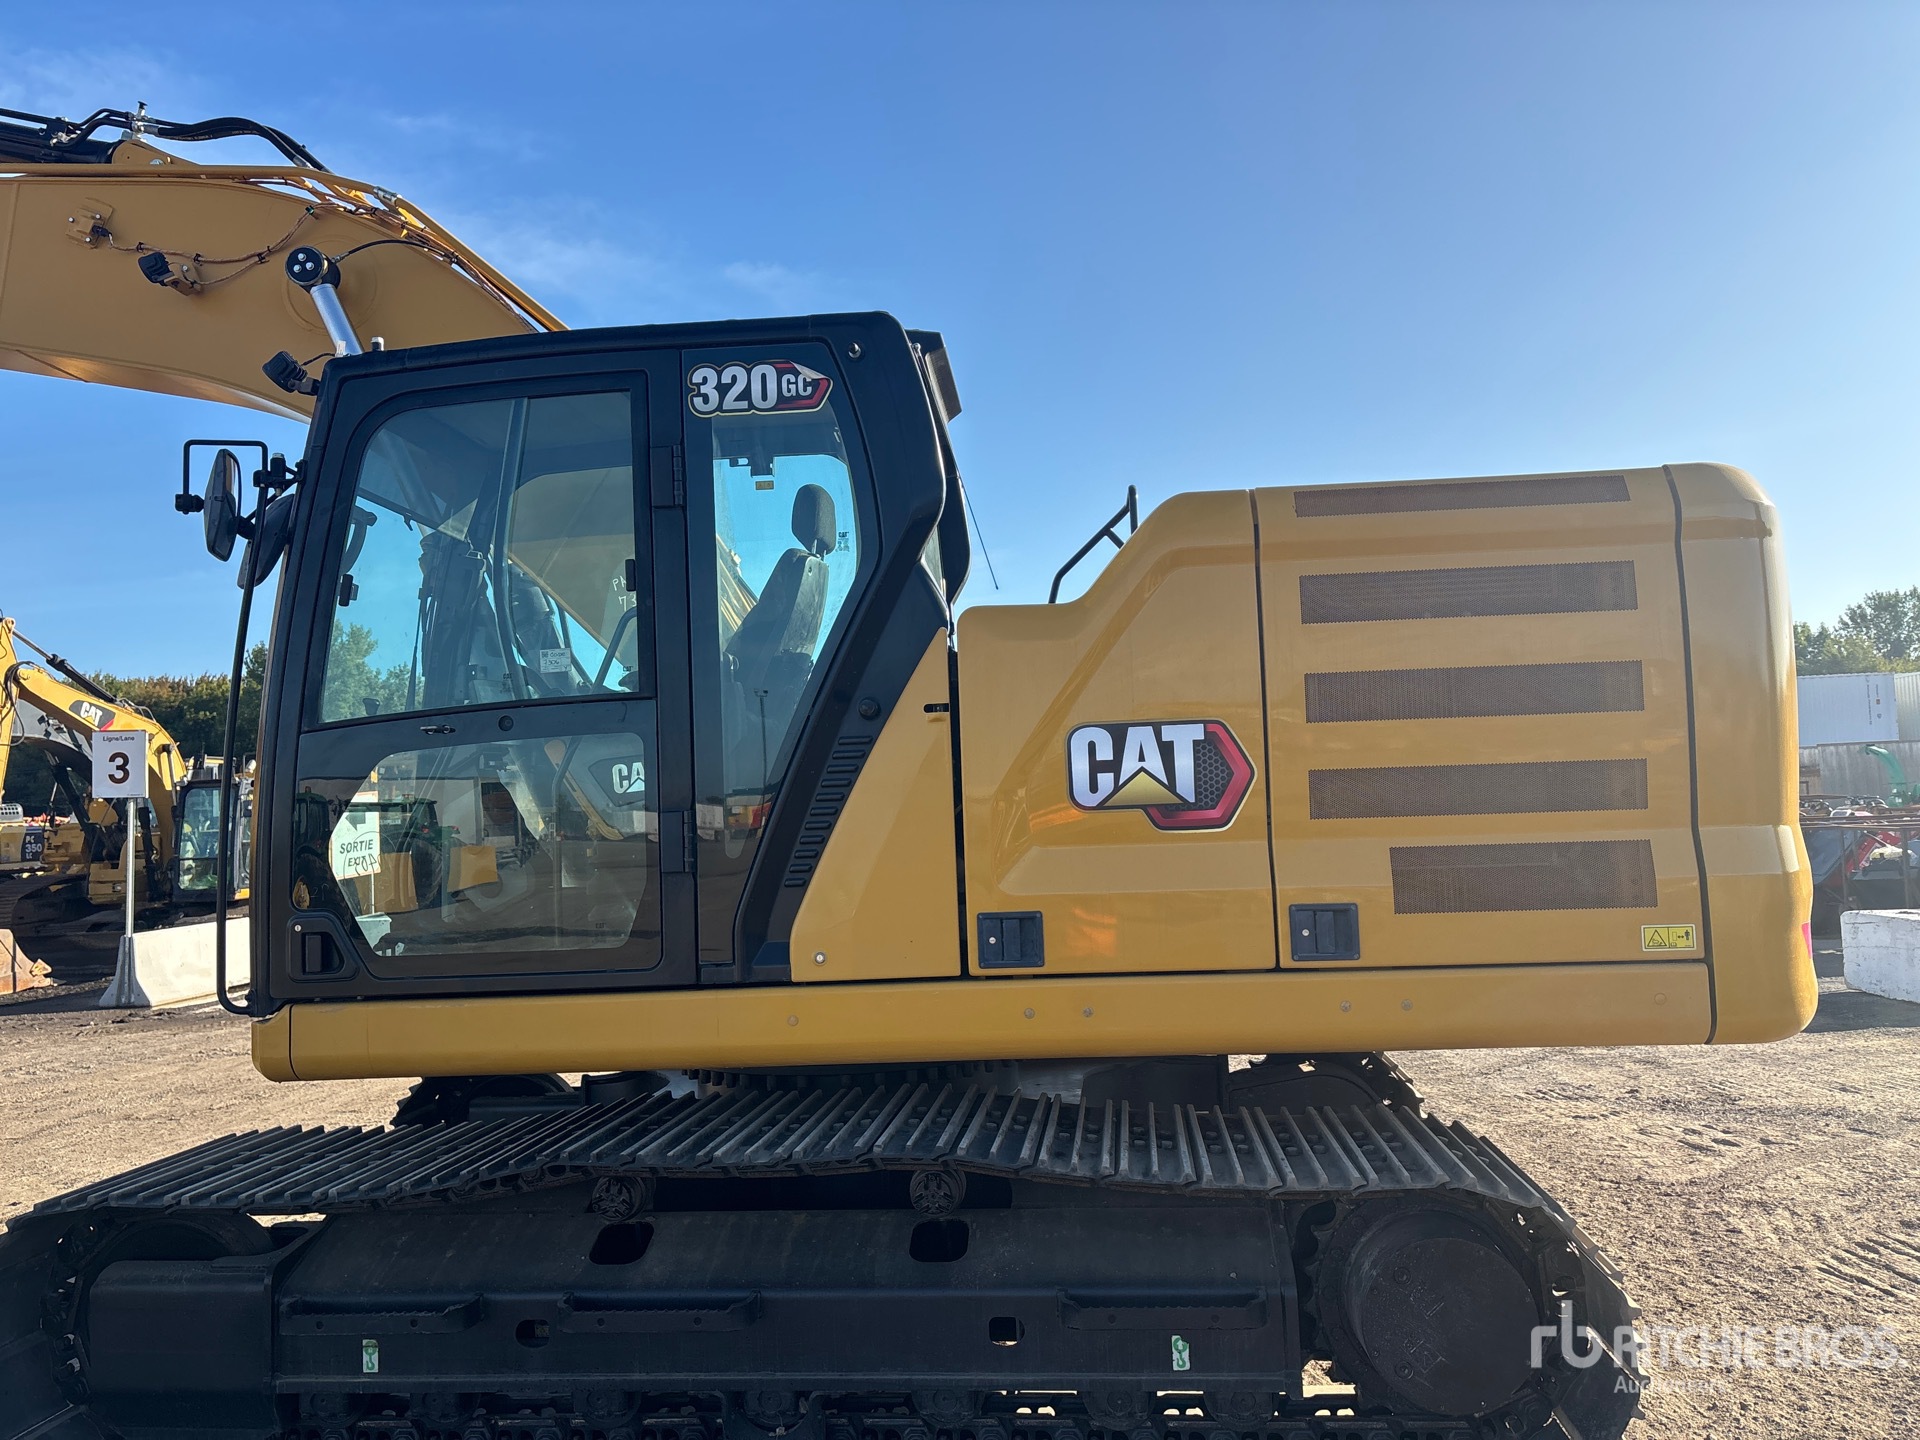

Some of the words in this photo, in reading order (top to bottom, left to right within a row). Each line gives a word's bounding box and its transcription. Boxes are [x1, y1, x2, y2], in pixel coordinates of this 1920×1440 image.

[692, 364, 778, 412] 320
[781, 373, 813, 397] GC
[80, 701, 103, 727] CAT
[107, 751, 130, 785] 3
[611, 761, 645, 794] CA
[1070, 723, 1205, 807] CAT
[25, 835, 35, 843] PC
[25, 843, 42, 853] 350
[339, 838, 374, 855] SORTIE
